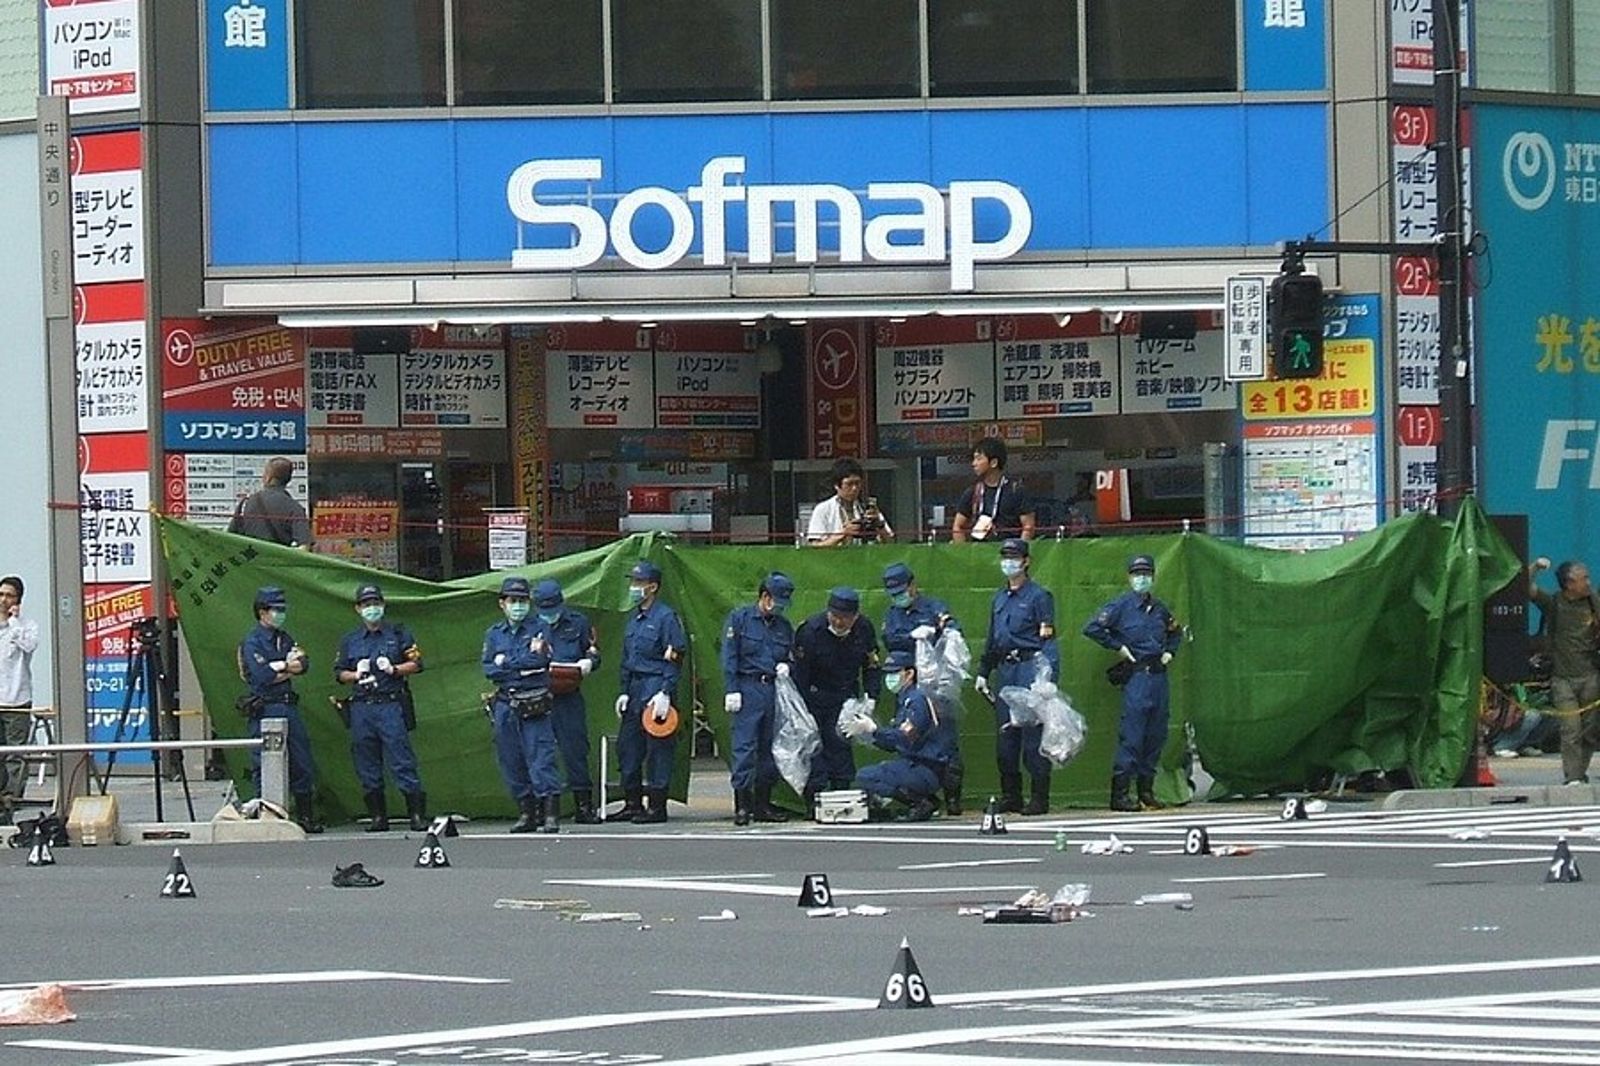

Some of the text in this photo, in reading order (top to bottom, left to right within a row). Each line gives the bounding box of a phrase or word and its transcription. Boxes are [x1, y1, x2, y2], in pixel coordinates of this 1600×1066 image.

[54, 20, 111, 44] パソコン
[224, 5, 266, 48] 館
[73, 48, 111, 70] iPod
[1400, 112, 1422, 140] 3F
[45, 122, 59, 207] 中央通り
[1564, 143, 1600, 172] NT
[1565, 176, 1600, 201] 東日
[506, 156, 1033, 294] Sofmap
[1402, 263, 1424, 290] 2F
[1247, 285, 1260, 335] 歩行者
[196, 330, 292, 367] DUTY FREE
[211, 361, 255, 379] TRAVEL
[257, 350, 296, 367] VALUE
[405, 353, 494, 370] デジタルカメラ
[568, 355, 631, 372] 薄型テレビ
[677, 357, 725, 373] パソコン
[1136, 358, 1174, 376] ホビー
[311, 373, 377, 390] 電話/FAX
[405, 374, 501, 391] デジタルビデオカメラ
[568, 376, 630, 391] レコーダー
[677, 377, 709, 391] iPod
[894, 370, 942, 386] サプライ
[1004, 366, 1054, 381] エアコン
[1400, 367, 1429, 389] 時計
[312, 393, 366, 411] 電子辞書
[405, 394, 432, 411] 時計
[570, 395, 631, 412] オーディオ
[894, 388, 976, 406] パソコンソフト
[181, 421, 296, 440] ソフマップ本館
[1407, 414, 1426, 439] 1F
[112, 591, 143, 612] FREE
[1283, 799, 1297, 818] 8
[1186, 829, 1202, 854] 6
[811, 876, 829, 905] 5
